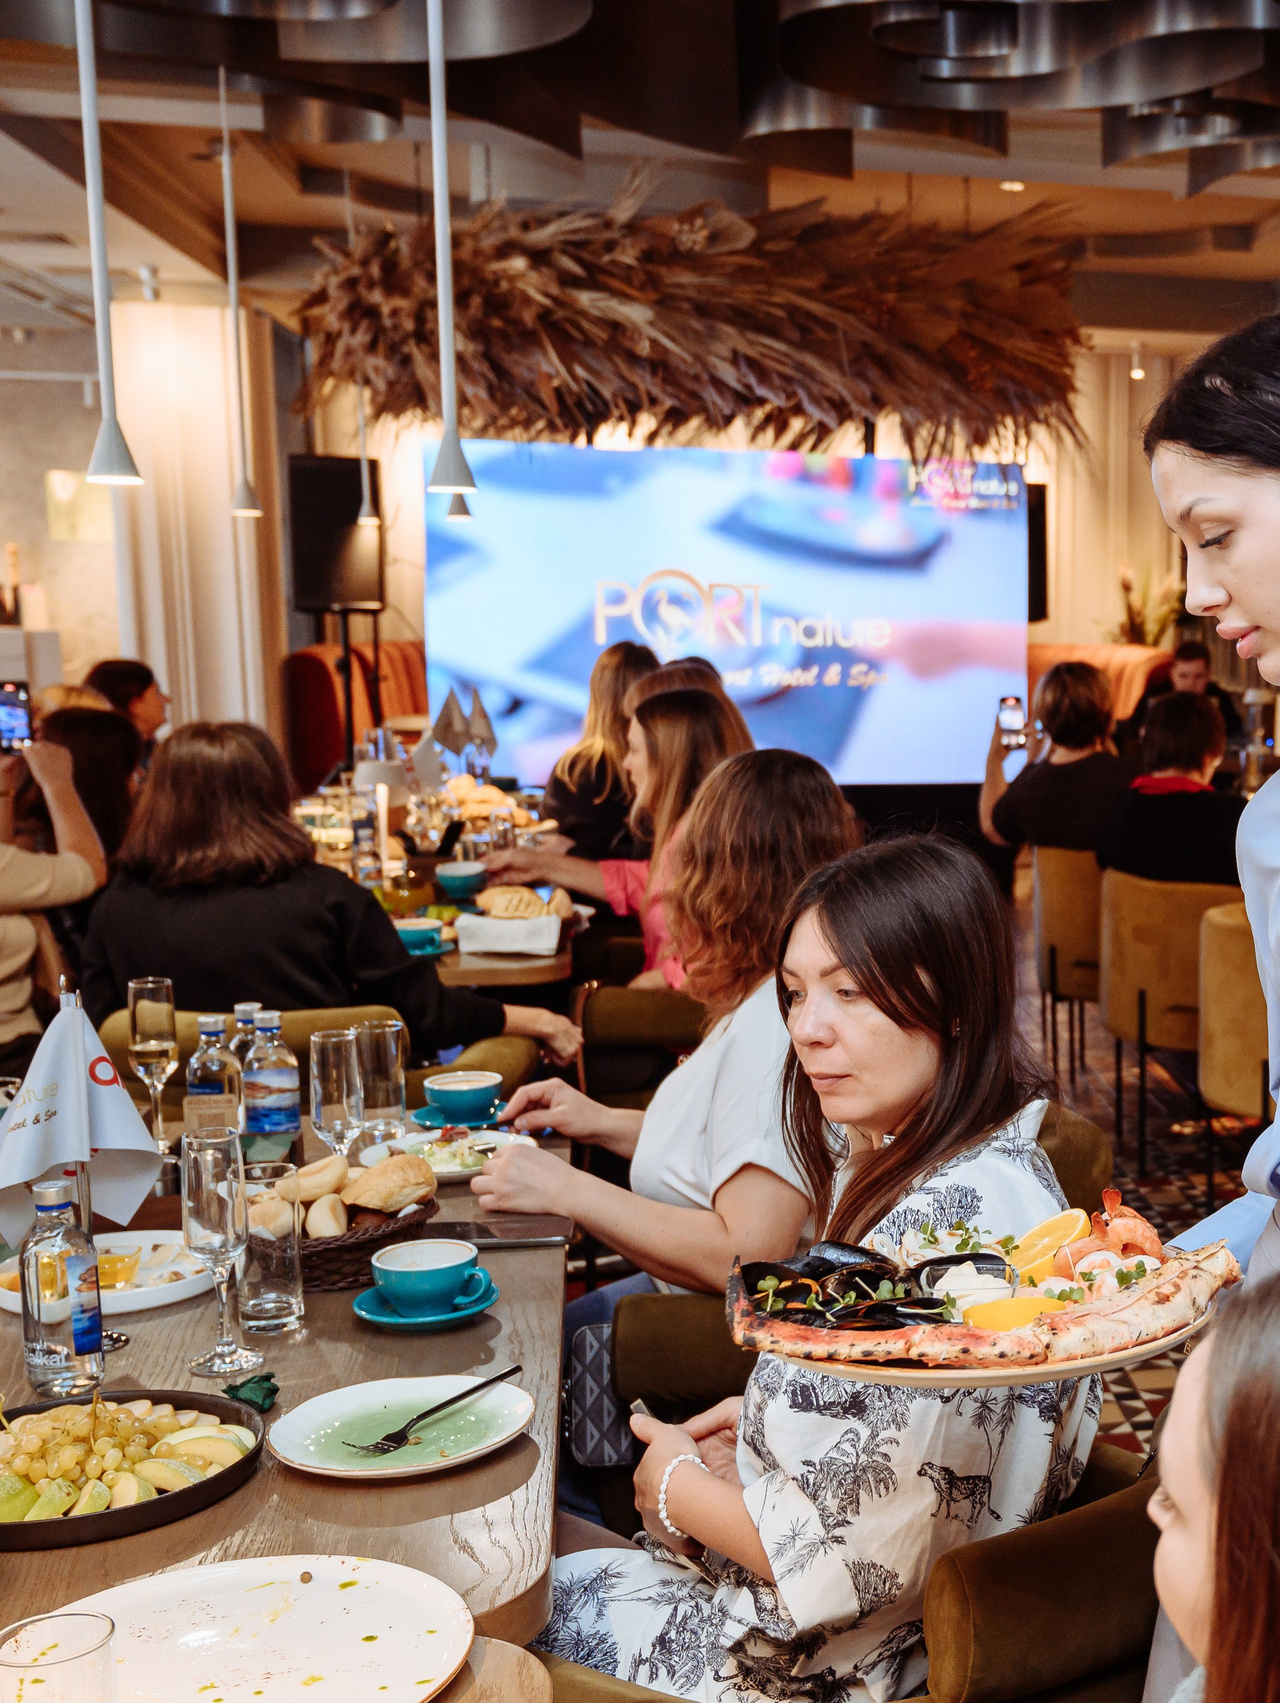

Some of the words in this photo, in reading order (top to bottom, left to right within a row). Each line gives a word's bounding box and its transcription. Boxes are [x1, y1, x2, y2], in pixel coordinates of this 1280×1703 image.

[594, 569, 772, 648] PORT
[772, 612, 893, 649] nature
[15, 1082, 59, 1109] ature
